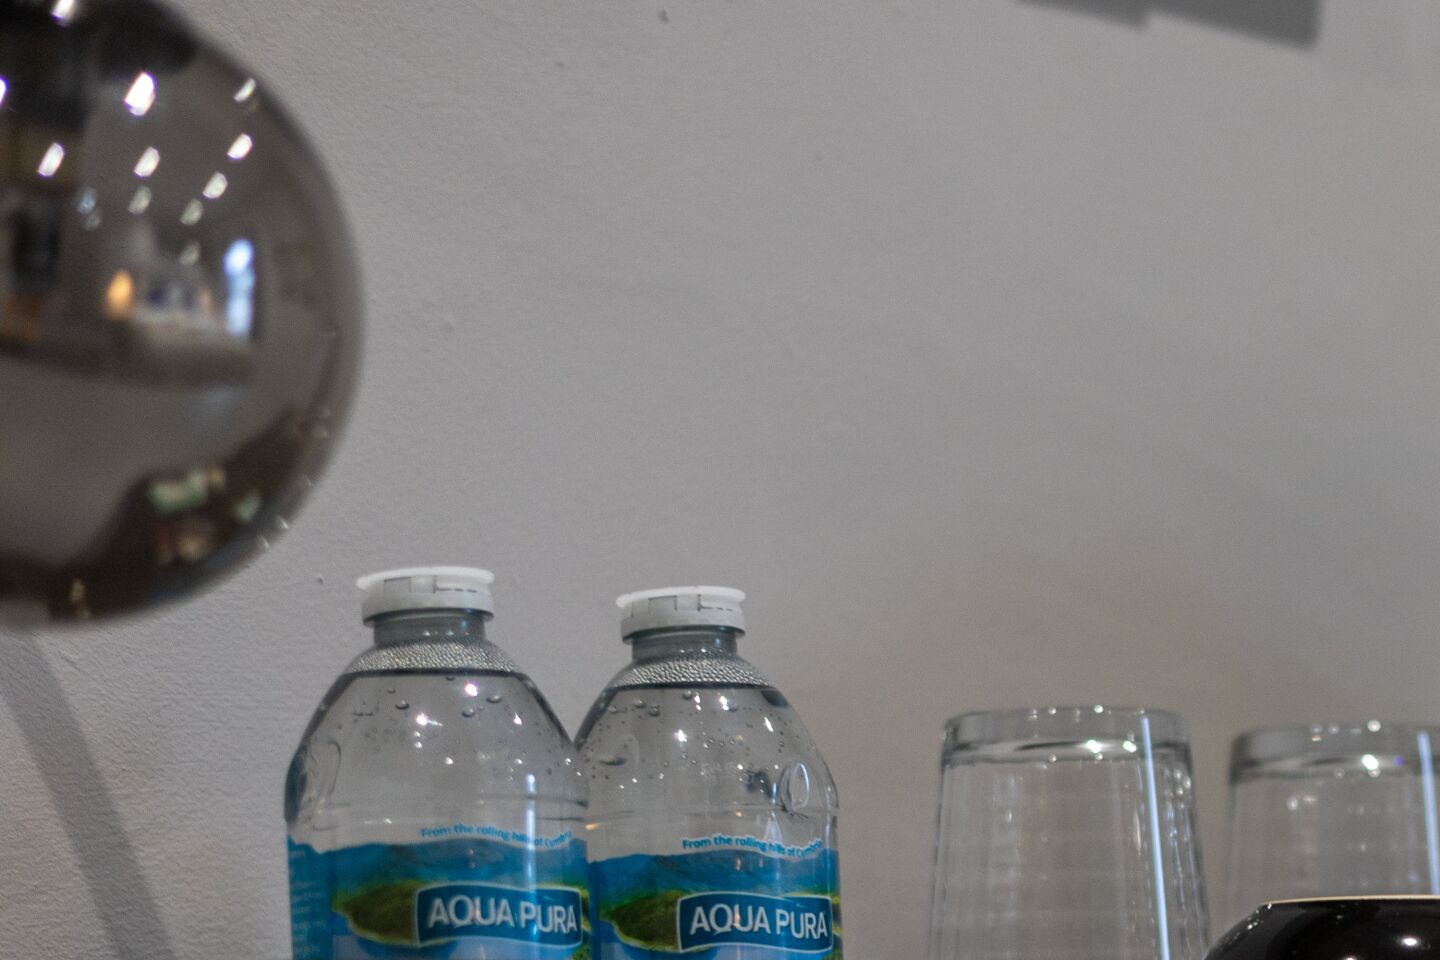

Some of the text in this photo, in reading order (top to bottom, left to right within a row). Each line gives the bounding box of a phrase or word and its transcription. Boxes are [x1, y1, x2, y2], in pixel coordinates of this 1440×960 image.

[421, 827, 449, 838] From
[454, 823, 472, 834] the
[477, 825, 510, 842] rolling
[682, 838, 711, 850] From
[714, 834, 733, 846] the
[735, 836, 767, 853] rolling
[428, 894, 578, 934] AQUA PURA
[689, 903, 829, 940] AQUA PURA
